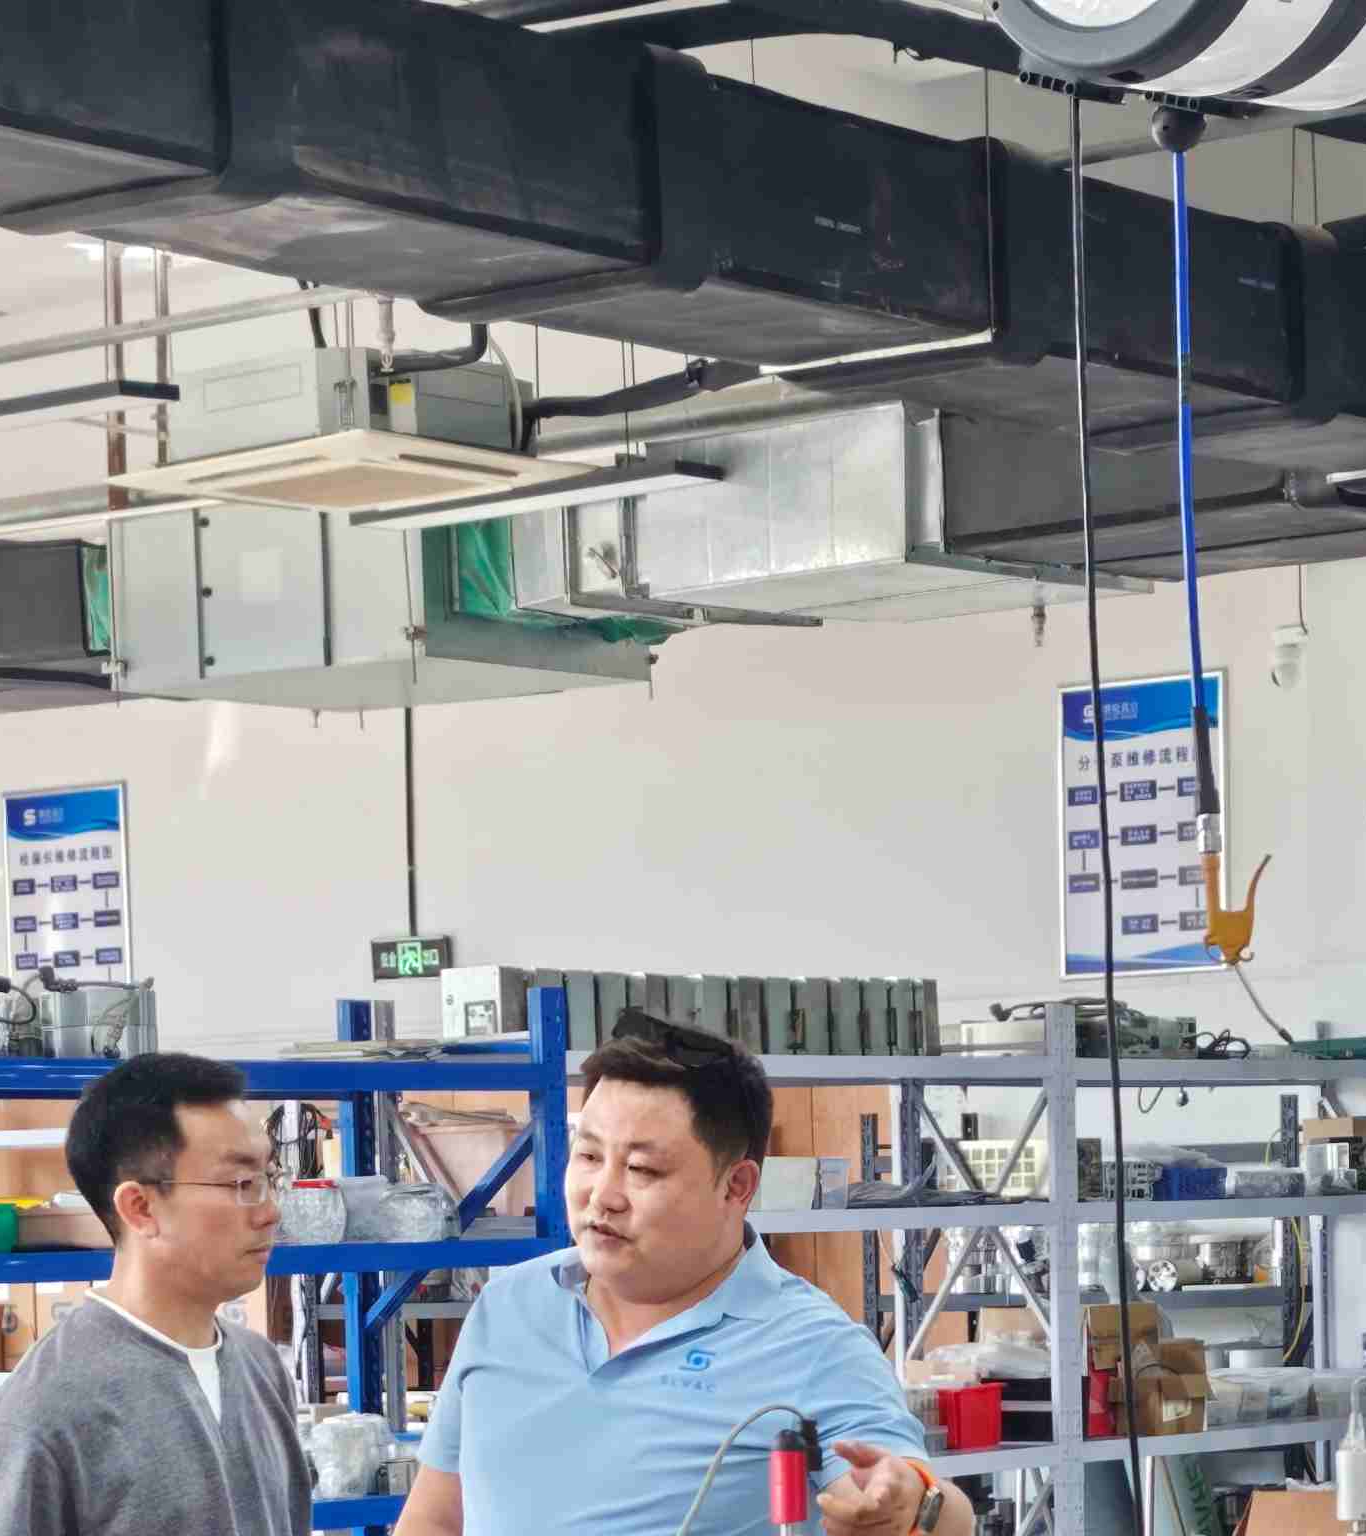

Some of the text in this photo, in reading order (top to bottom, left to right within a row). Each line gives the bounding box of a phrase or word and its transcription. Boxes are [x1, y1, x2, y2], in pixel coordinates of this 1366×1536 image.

[1078, 746, 1200, 772] 分泵维修流程
